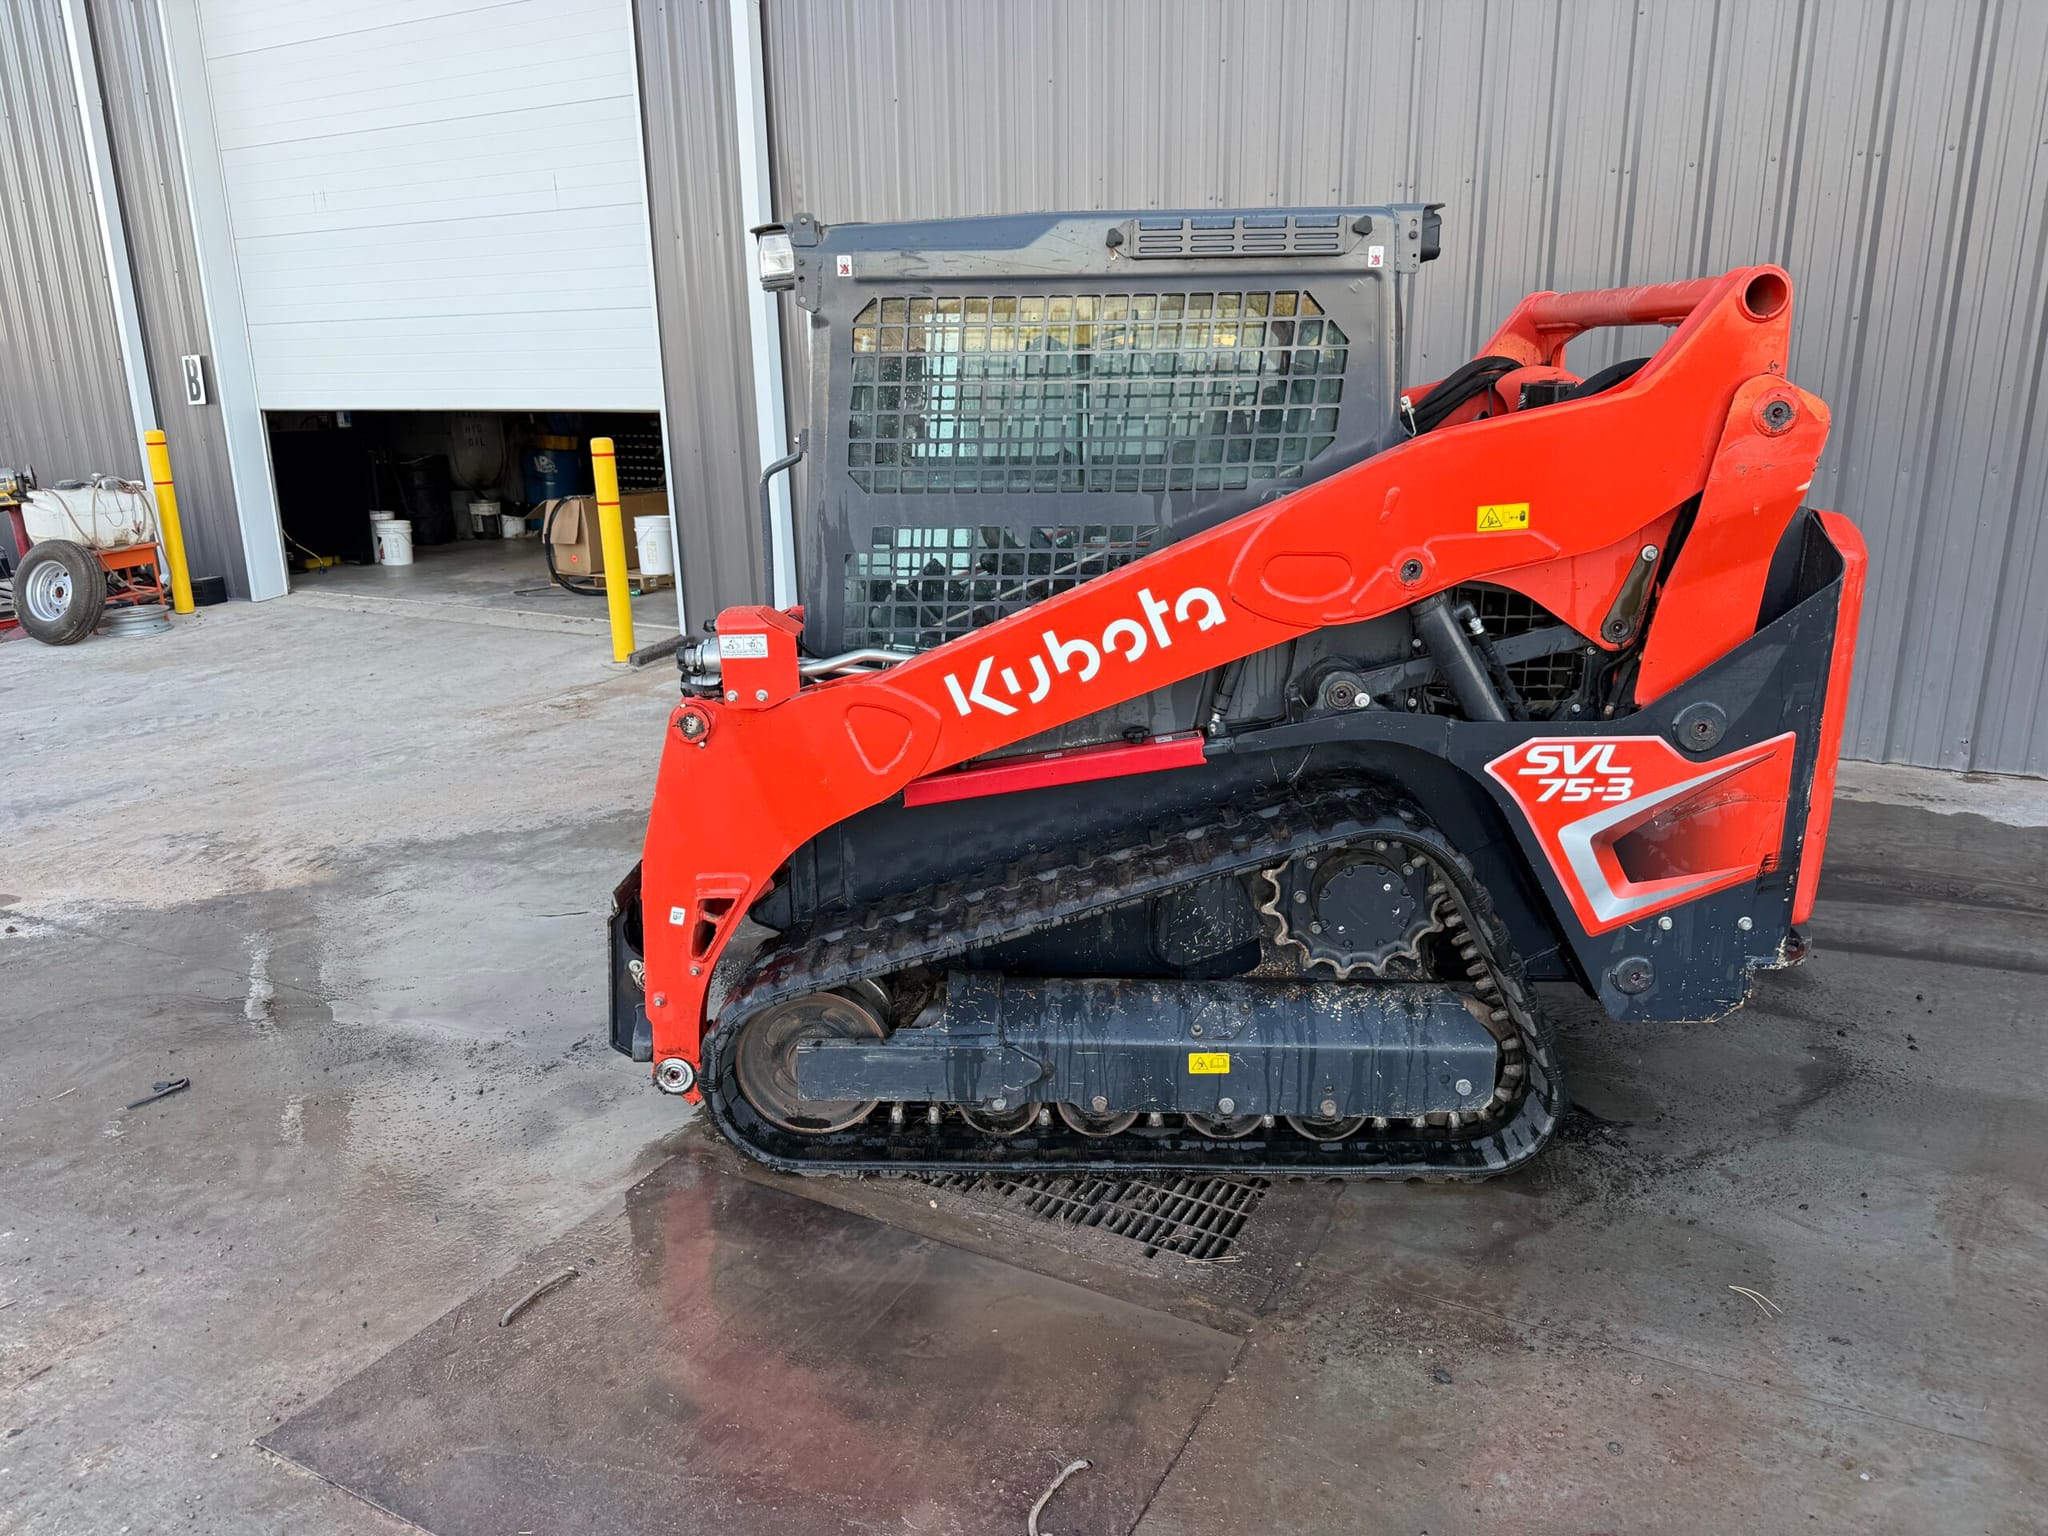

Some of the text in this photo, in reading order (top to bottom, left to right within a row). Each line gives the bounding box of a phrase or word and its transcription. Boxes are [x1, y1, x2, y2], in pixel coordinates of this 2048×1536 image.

[184, 359, 202, 402] B
[943, 587, 1227, 717] Kubota
[1517, 744, 1633, 776] SVL
[1536, 778, 1635, 802] 75-3
